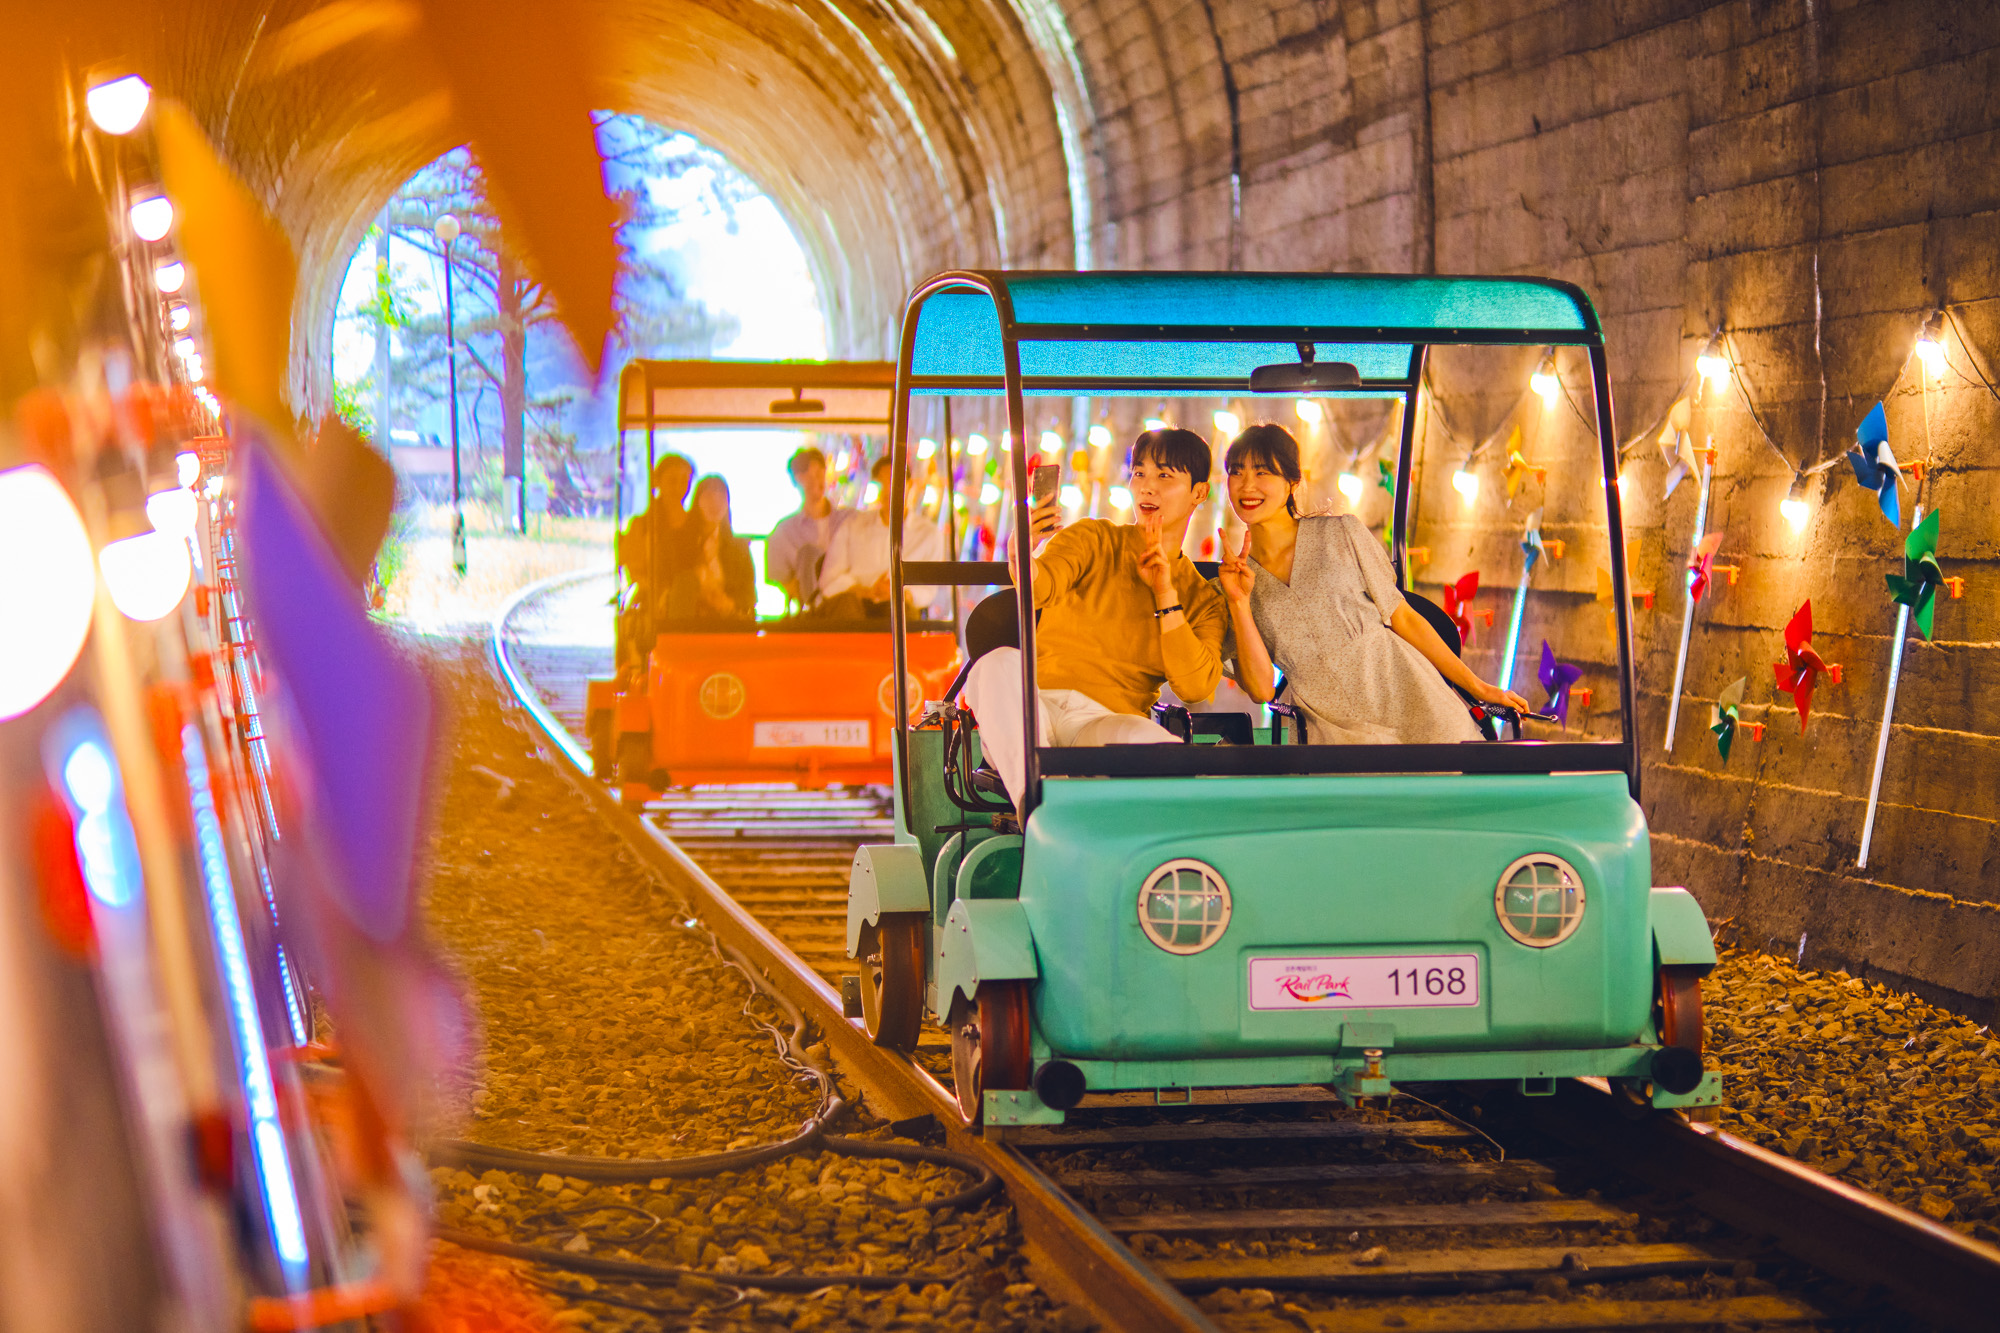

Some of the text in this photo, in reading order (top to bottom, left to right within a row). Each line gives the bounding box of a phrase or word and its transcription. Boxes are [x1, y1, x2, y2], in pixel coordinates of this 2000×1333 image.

[1275, 974, 1351, 996] Rail Park
[1388, 967, 1467, 996] 1168
